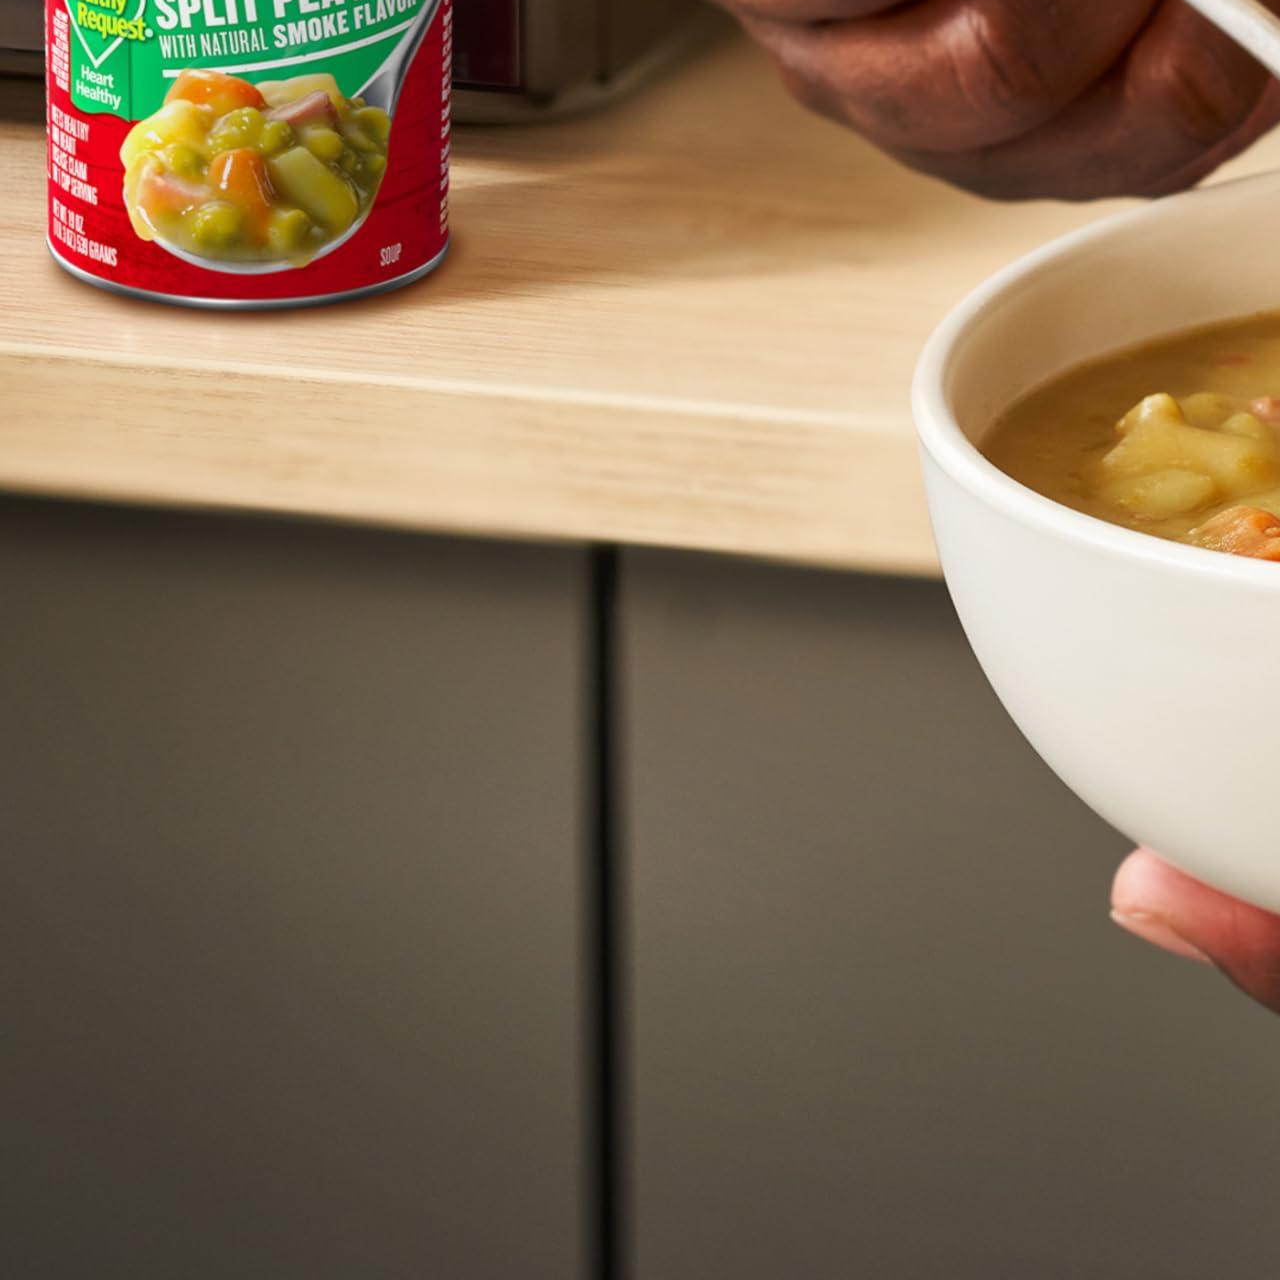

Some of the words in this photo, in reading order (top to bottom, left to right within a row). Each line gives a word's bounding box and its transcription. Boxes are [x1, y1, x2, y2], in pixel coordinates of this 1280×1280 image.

[77, 1, 147, 42] Request
[158, 33, 197, 59] WITH
[201, 27, 270, 58] NATURAL
[272, 10, 350, 49] SMOKE
[80, 64, 115, 89] Heart
[75, 79, 122, 111] Healthy
[89, 239, 118, 268] GRAMS
